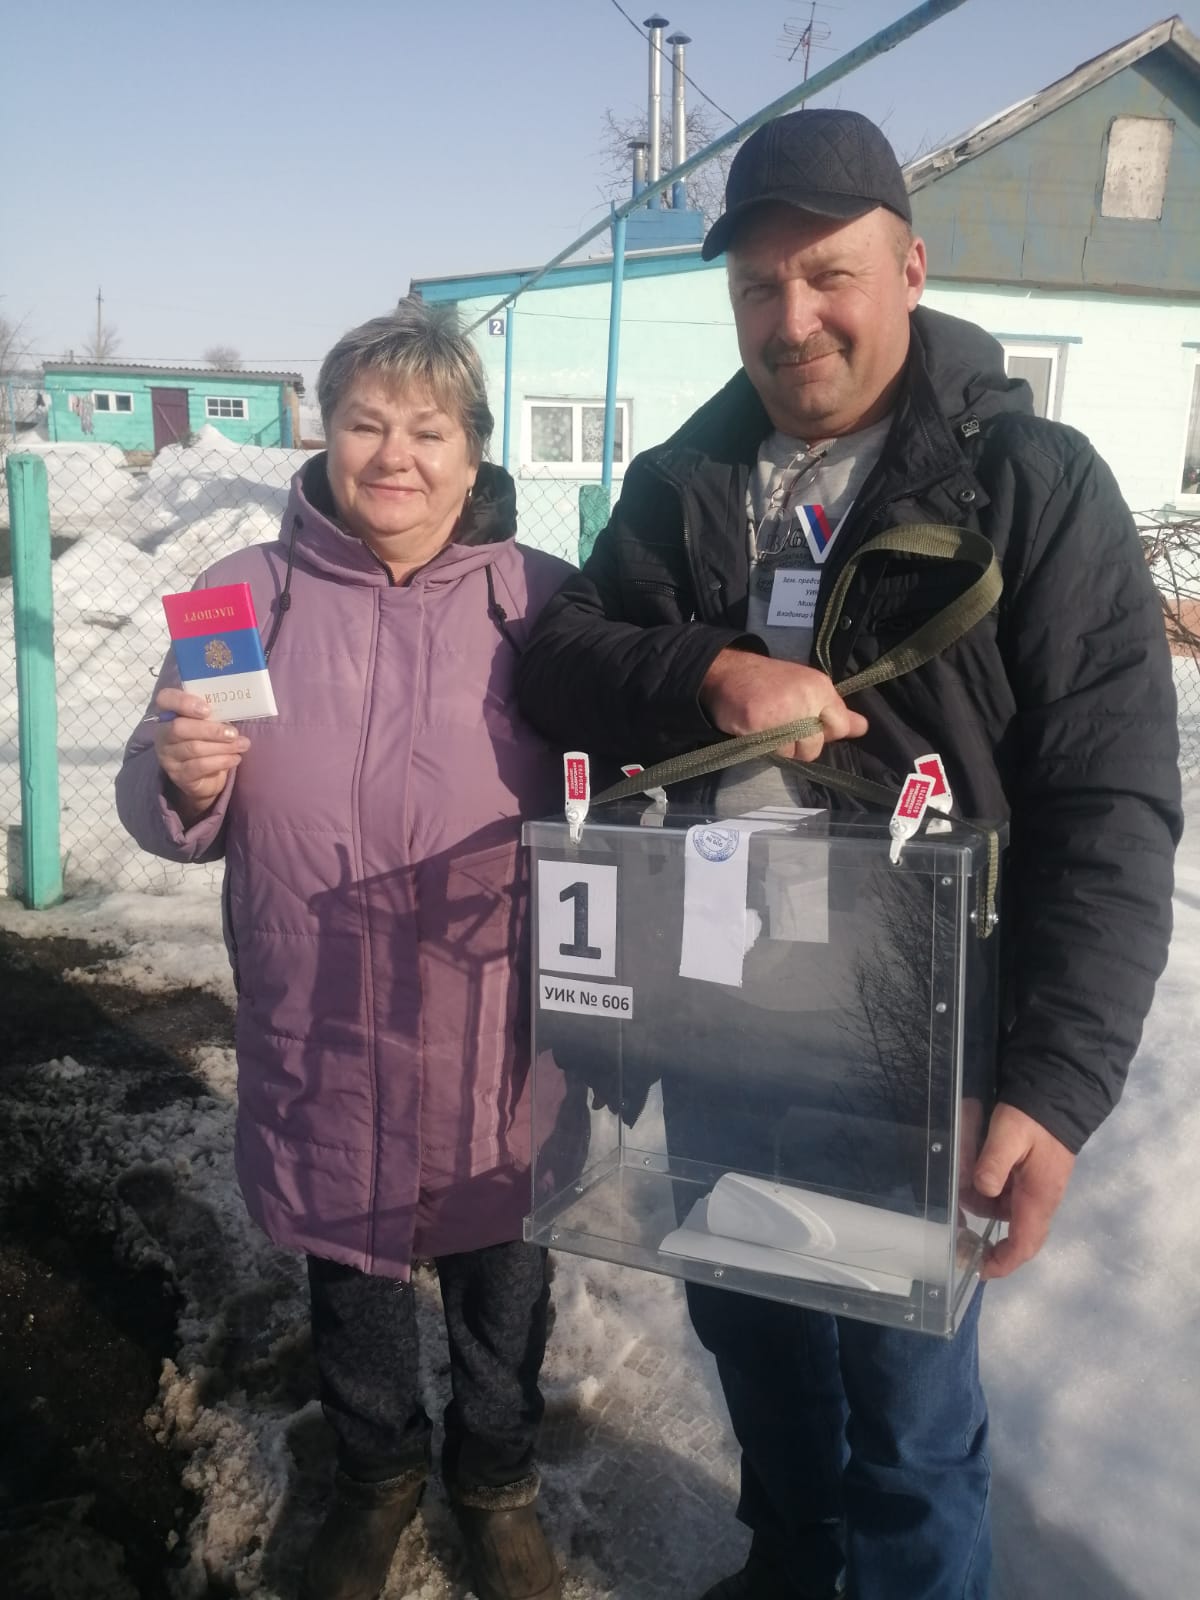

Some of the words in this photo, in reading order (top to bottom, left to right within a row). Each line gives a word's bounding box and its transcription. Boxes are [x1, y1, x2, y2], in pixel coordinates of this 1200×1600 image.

[493, 320, 502, 334] 2
[184, 606, 234, 623] ПАСПОРТ
[204, 688, 252, 704] РОССИЯ
[559, 881, 602, 960] 1
[544, 986, 575, 1004] УИК
[580, 991, 598, 1008] №
[602, 995, 630, 1012] 606
